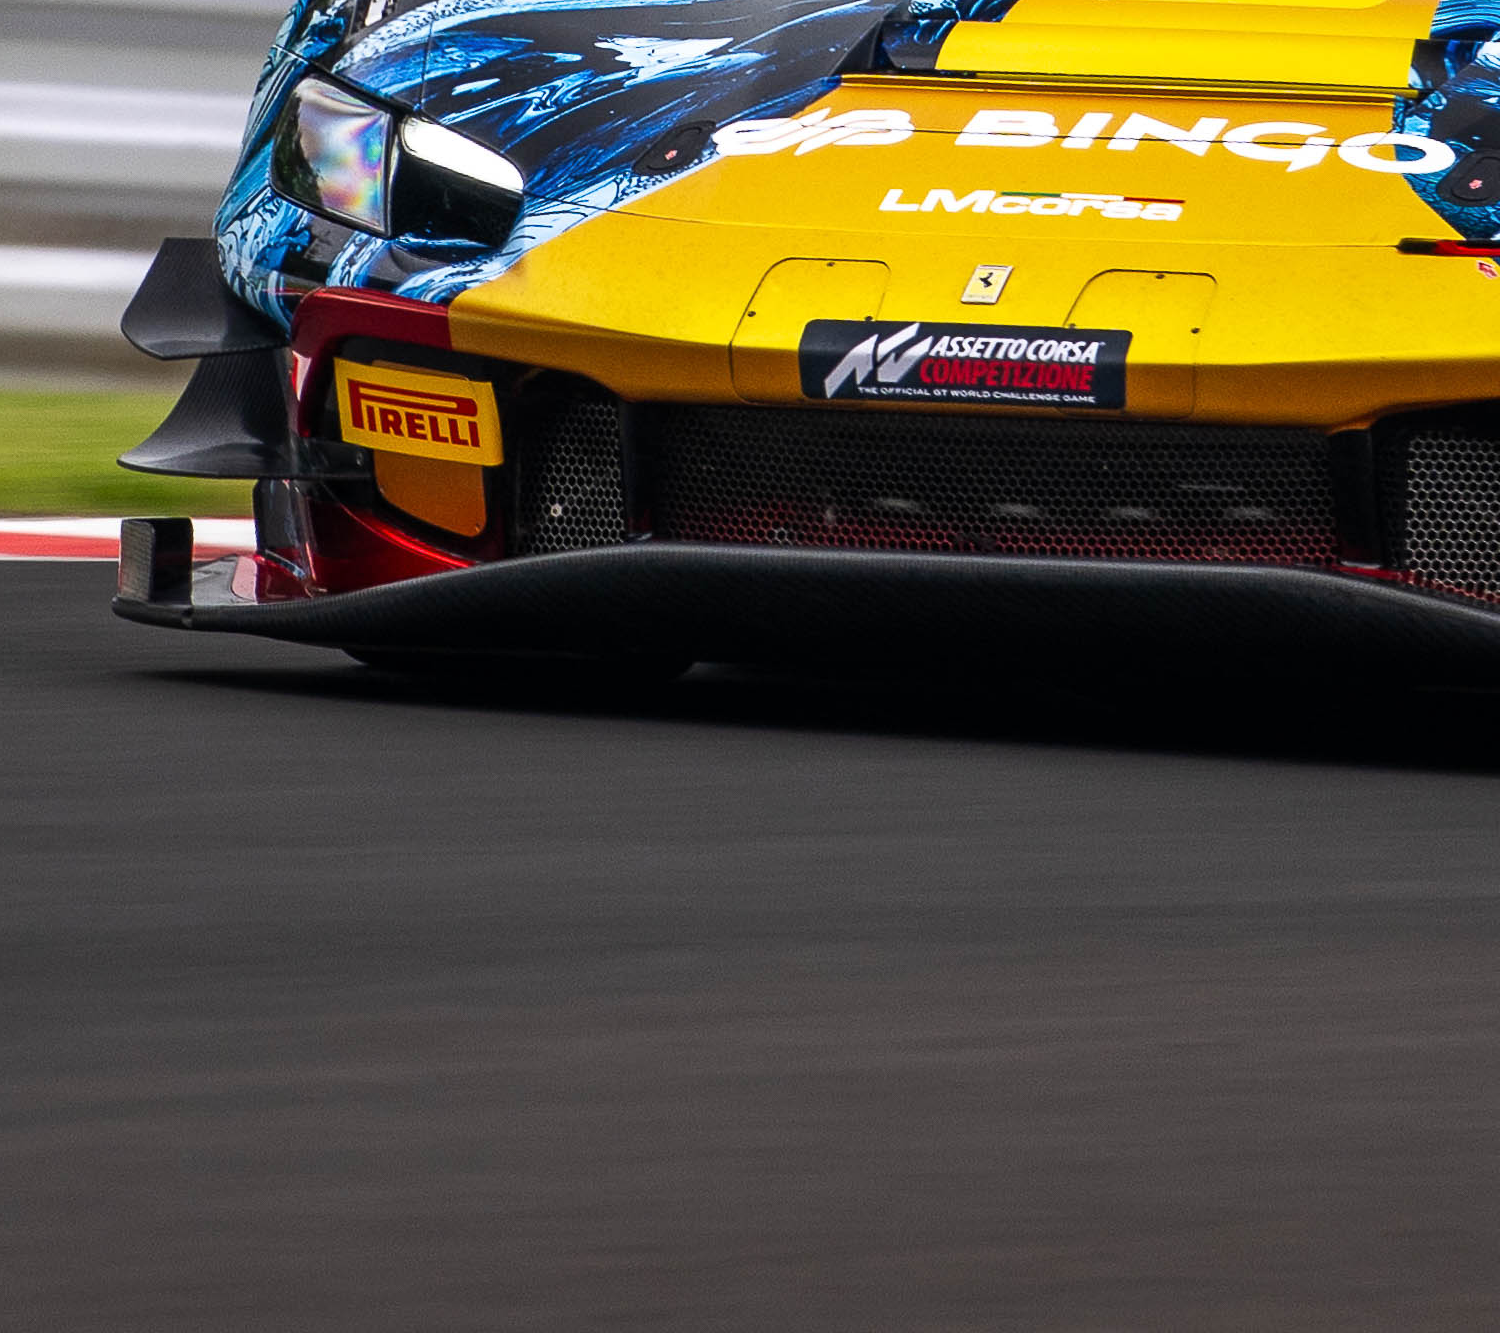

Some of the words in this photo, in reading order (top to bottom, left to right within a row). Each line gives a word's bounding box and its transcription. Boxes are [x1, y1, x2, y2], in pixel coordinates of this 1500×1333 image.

[954, 109, 1456, 174] BINGO
[879, 188, 1184, 223] LMcorsa
[919, 358, 1095, 392] COMPETIZIONE
[880, 387, 931, 396] OFFICIAL
[950, 389, 991, 399] WORLD
[992, 390, 1061, 402] CHALLENGE
[347, 378, 481, 448] PIRELLI
